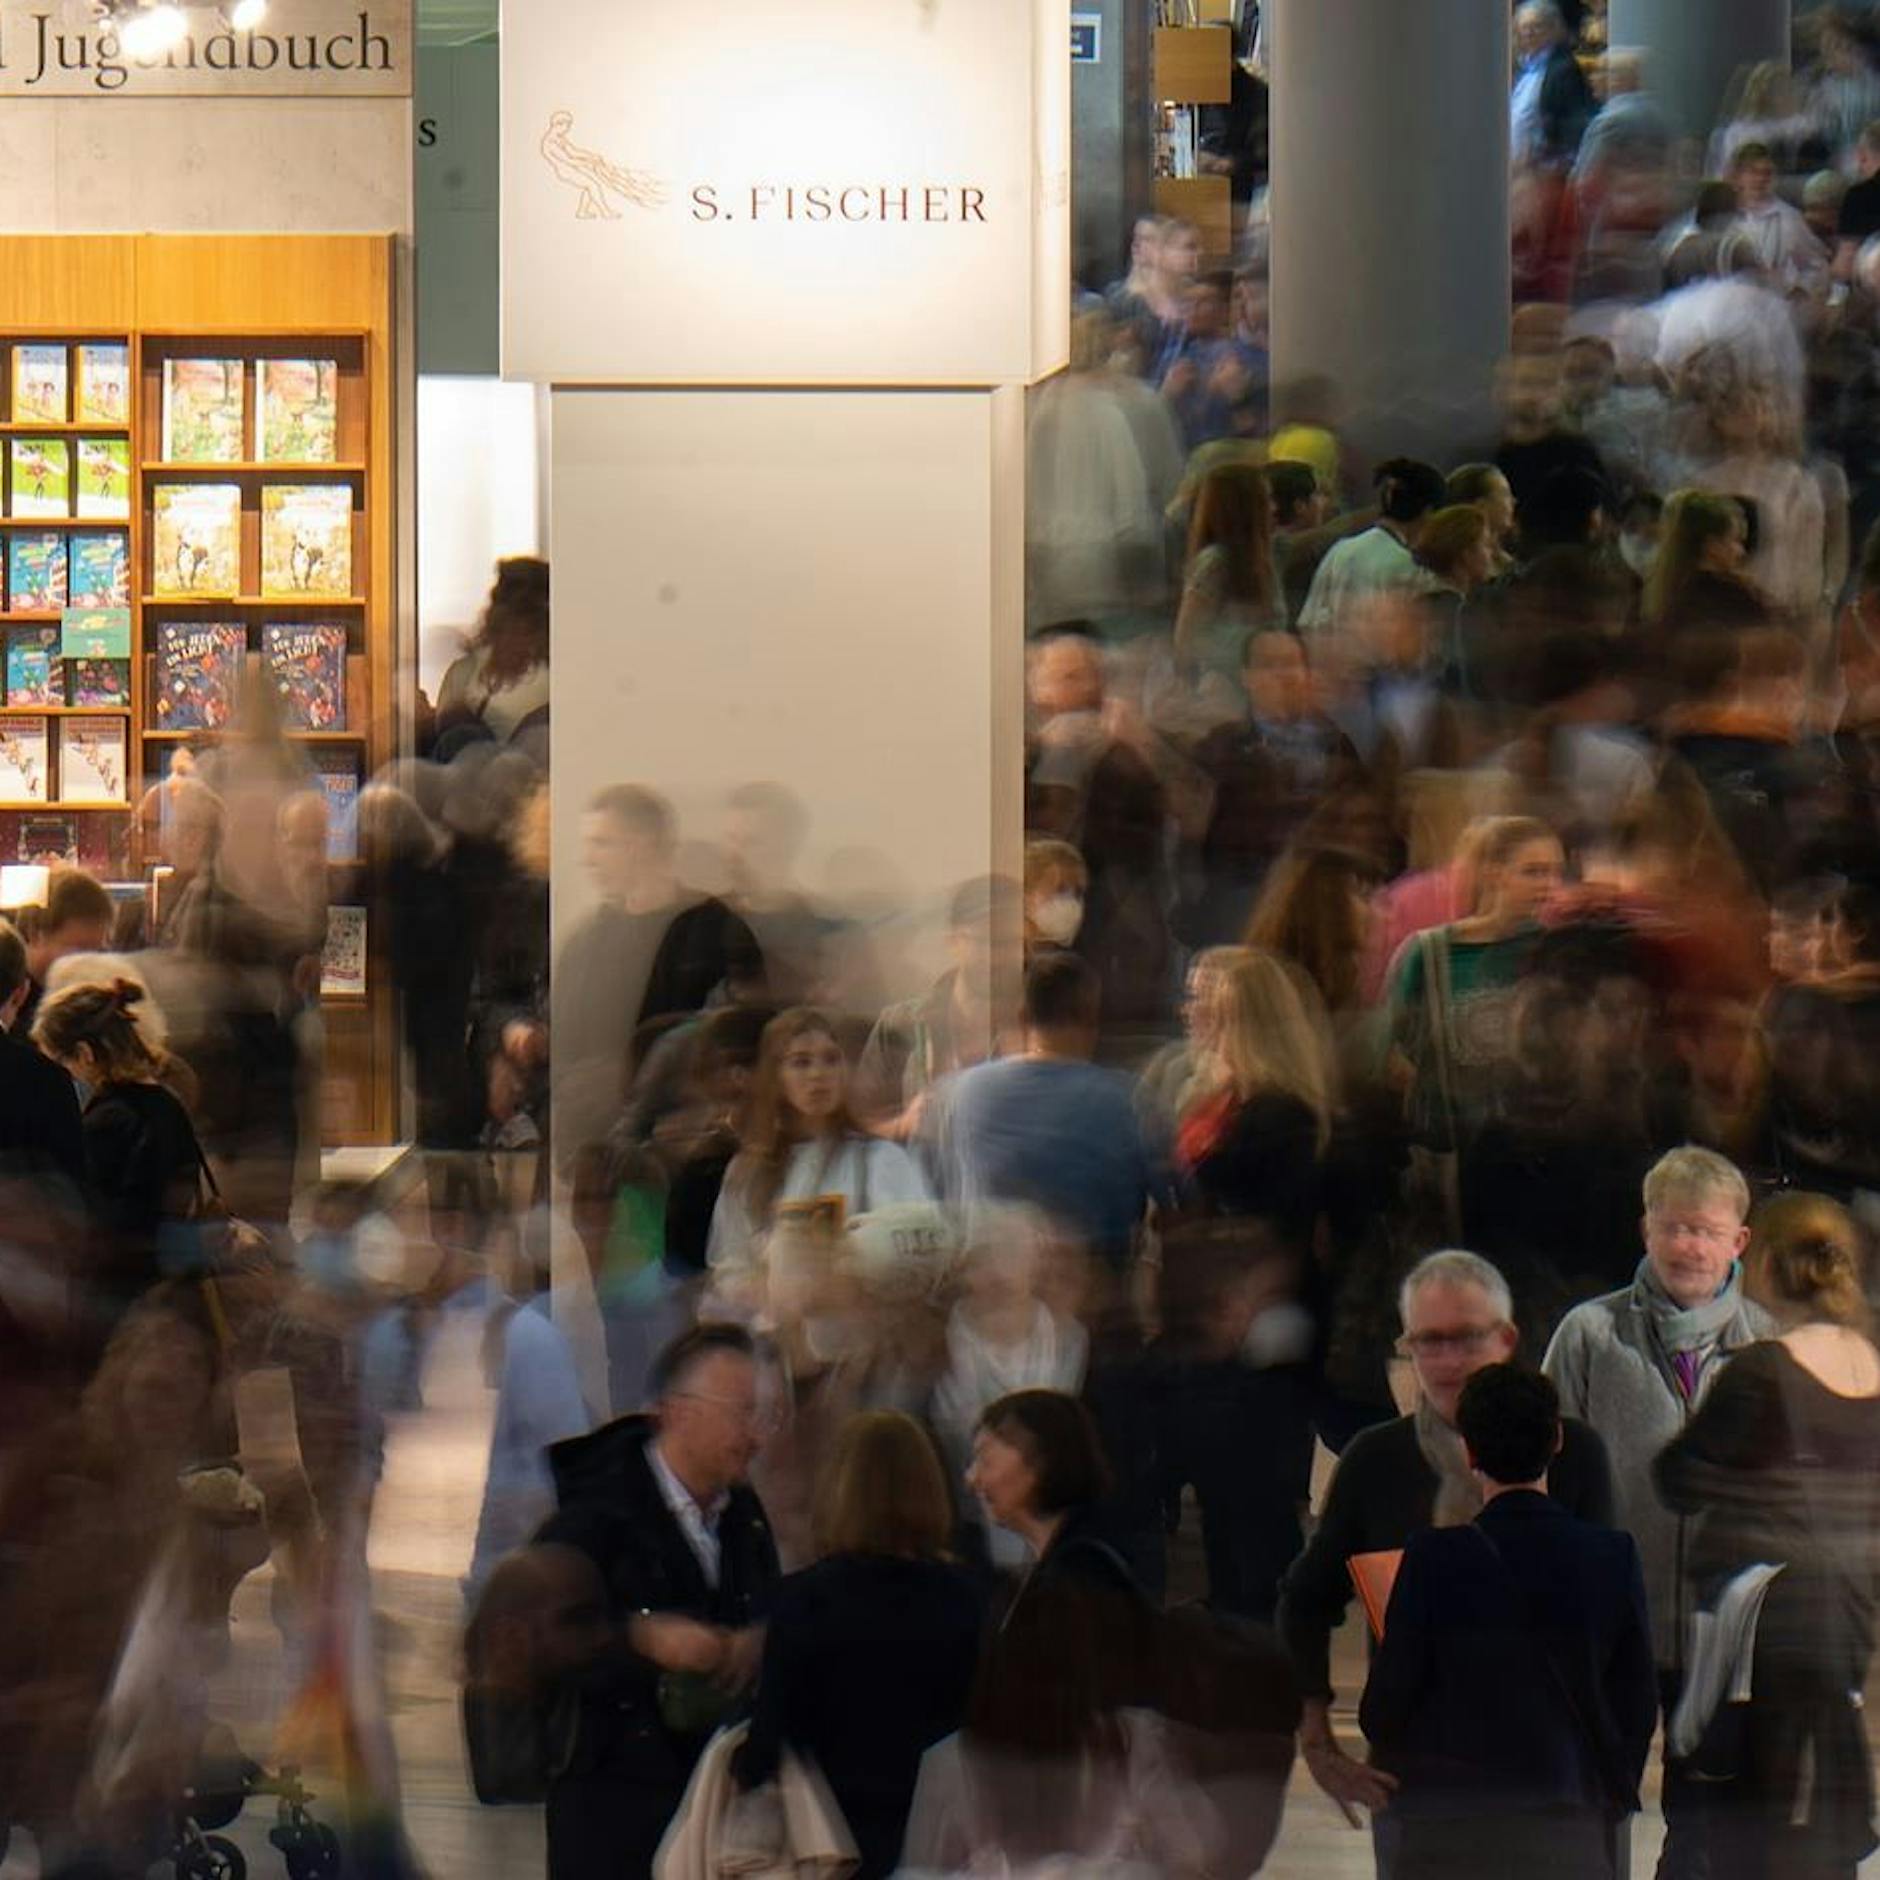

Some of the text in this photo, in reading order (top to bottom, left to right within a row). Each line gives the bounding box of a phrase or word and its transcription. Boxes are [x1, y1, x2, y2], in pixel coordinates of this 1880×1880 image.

[25, 12, 393, 89] Jugndbuch
[691, 185, 989, 223] S. FISCHER
